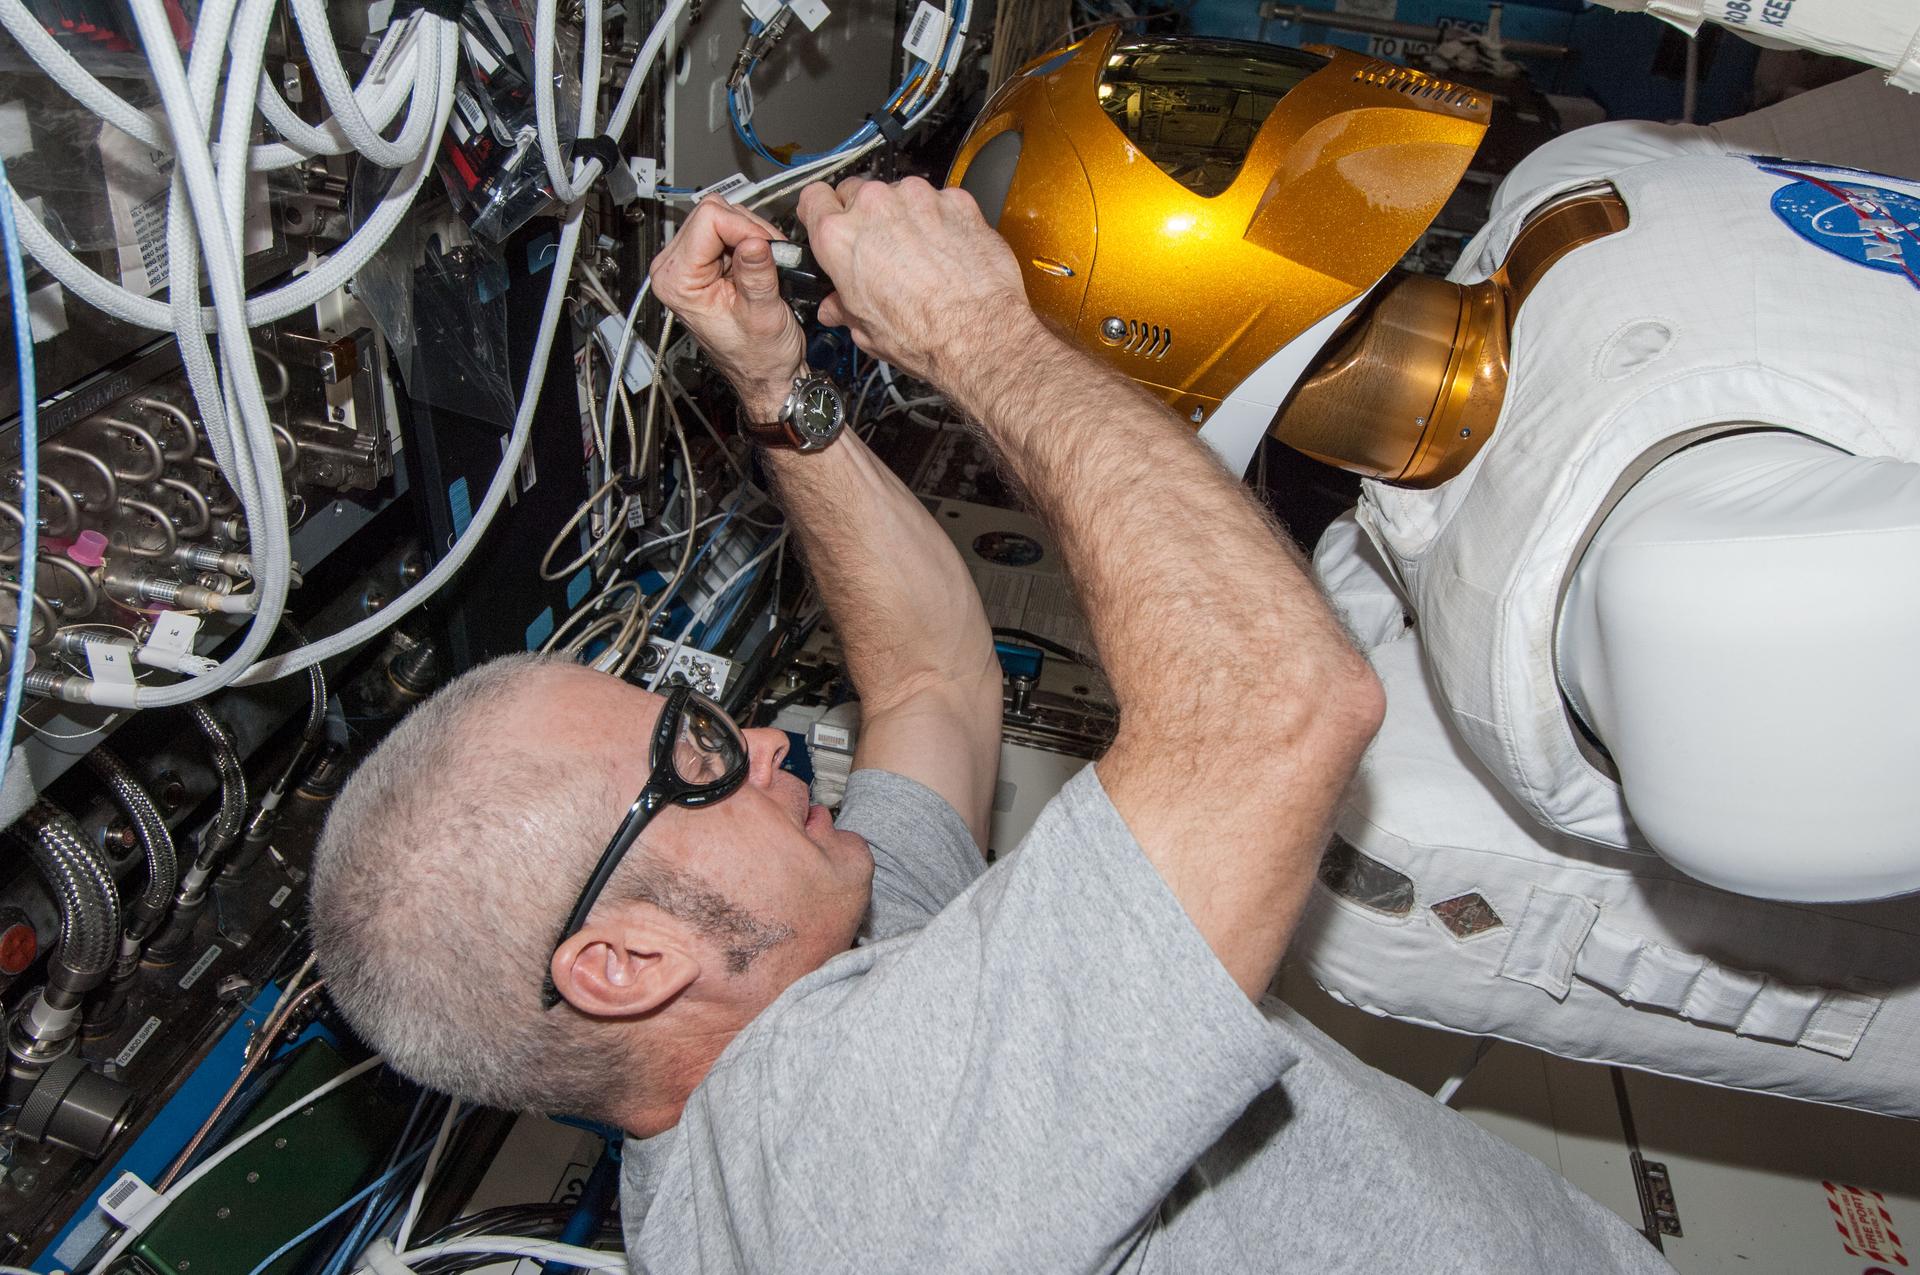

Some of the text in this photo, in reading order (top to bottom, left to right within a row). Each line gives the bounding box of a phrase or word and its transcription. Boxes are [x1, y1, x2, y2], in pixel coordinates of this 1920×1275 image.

[1723, 0, 1752, 25] ROB
[1760, 0, 1794, 27] KEE
[1373, 37, 1397, 55] TO
[140, 241, 153, 253] MSG
[142, 250, 155, 261] MSG
[145, 258, 157, 270] MSG
[146, 267, 159, 278] MSG
[149, 275, 161, 286] MSG
[192, 965, 203, 977] MOD
[119, 1017, 159, 1064] TCS MOD SUPPLY
[1851, 1195, 1869, 1224] PORT
[1863, 1226, 1880, 1251] FIRE
